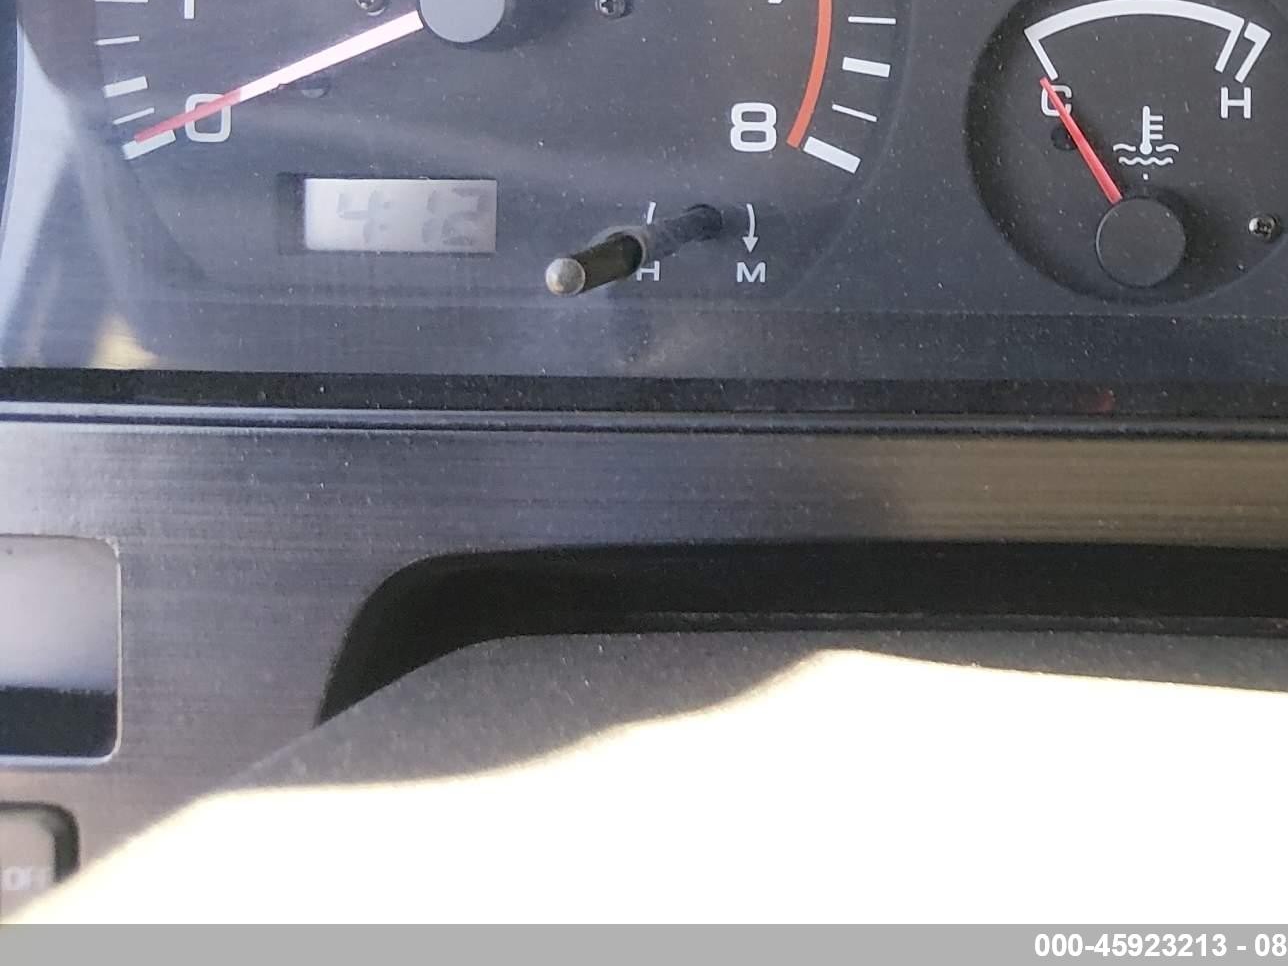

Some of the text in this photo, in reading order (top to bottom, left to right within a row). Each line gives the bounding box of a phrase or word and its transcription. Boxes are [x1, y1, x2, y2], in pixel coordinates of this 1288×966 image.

[1040, 84, 1071, 117] C
[1220, 86, 1252, 119] H
[182, 93, 231, 143] 0
[730, 102, 777, 152] 8
[736, 261, 766, 283] M
